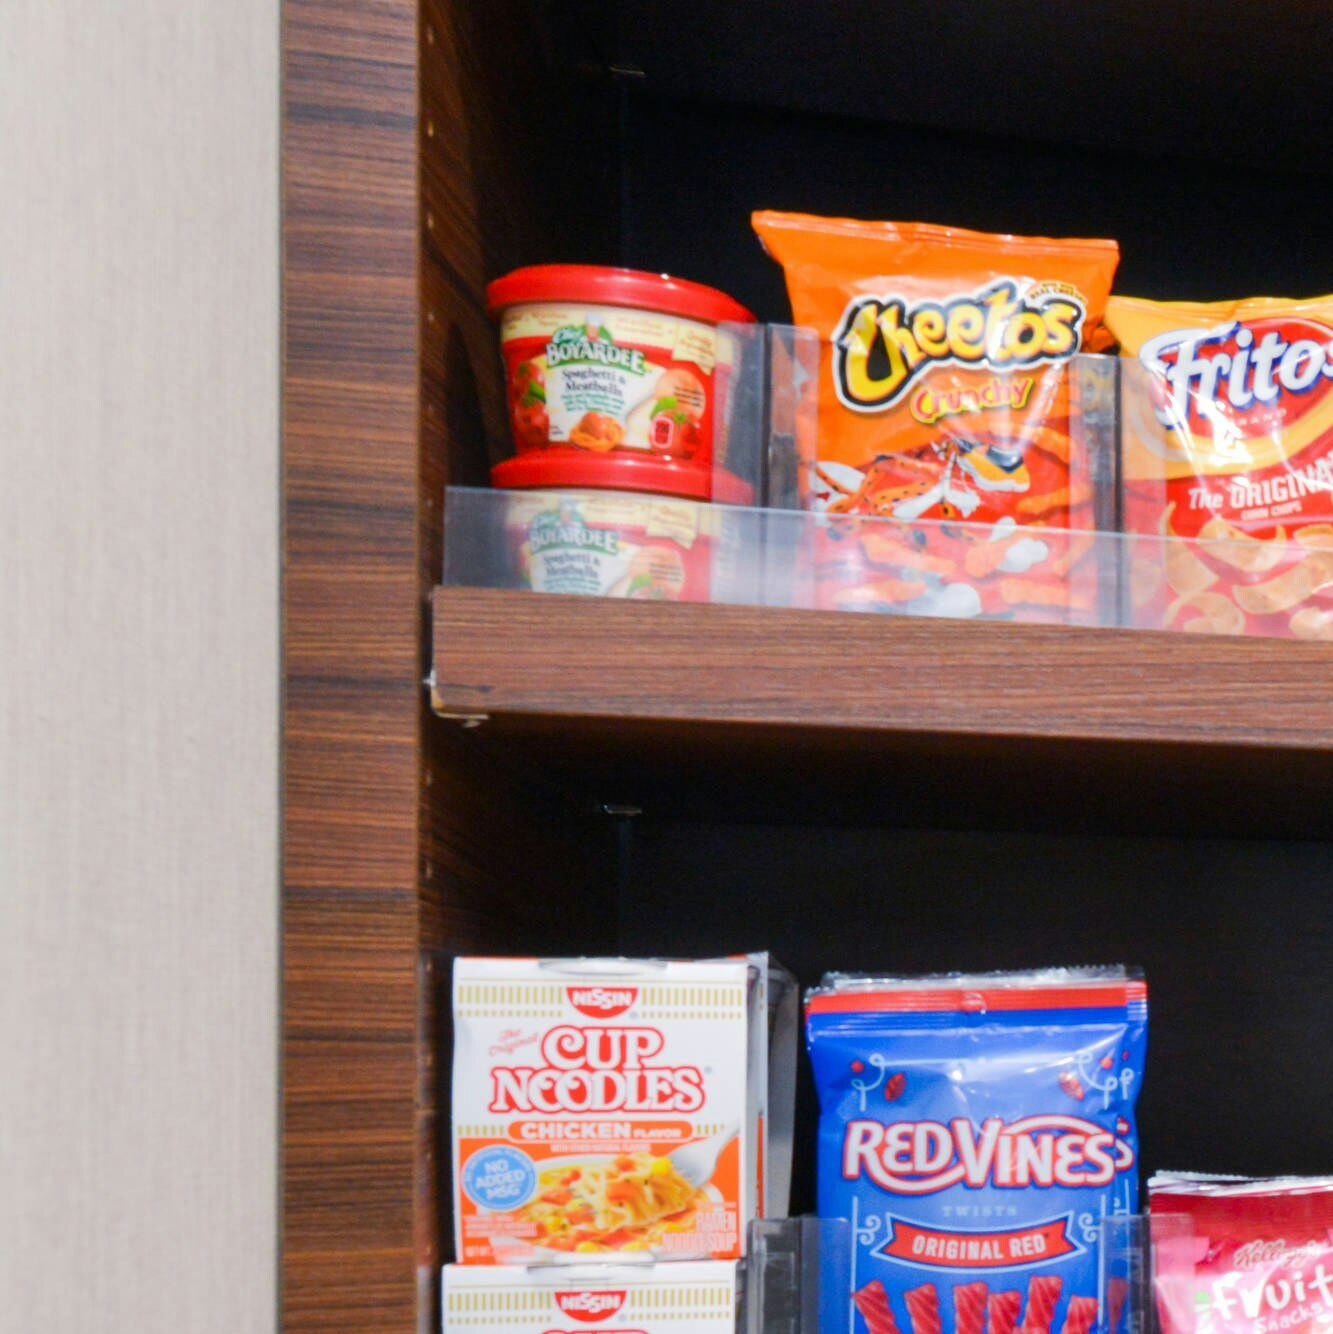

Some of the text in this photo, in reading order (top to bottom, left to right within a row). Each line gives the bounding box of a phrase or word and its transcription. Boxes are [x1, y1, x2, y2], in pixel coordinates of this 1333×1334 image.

[838, 282, 1081, 408] Cheetos
[546, 342, 646, 374] BOYARDEE
[910, 376, 1033, 424] Crunchy
[1189, 486, 1224, 510] The
[573, 988, 633, 1009] NISSIN
[541, 1025, 664, 1069] CUP
[489, 1066, 705, 1113] NOODLES
[520, 1122, 632, 1141] CHICKEN
[477, 1169, 526, 1188] ADDED
[486, 1160, 509, 1174] NO
[487, 1184, 521, 1199] MSG
[911, 1230, 1048, 1261] ORIGINAL RED
[560, 1292, 621, 1313] NISSIN
